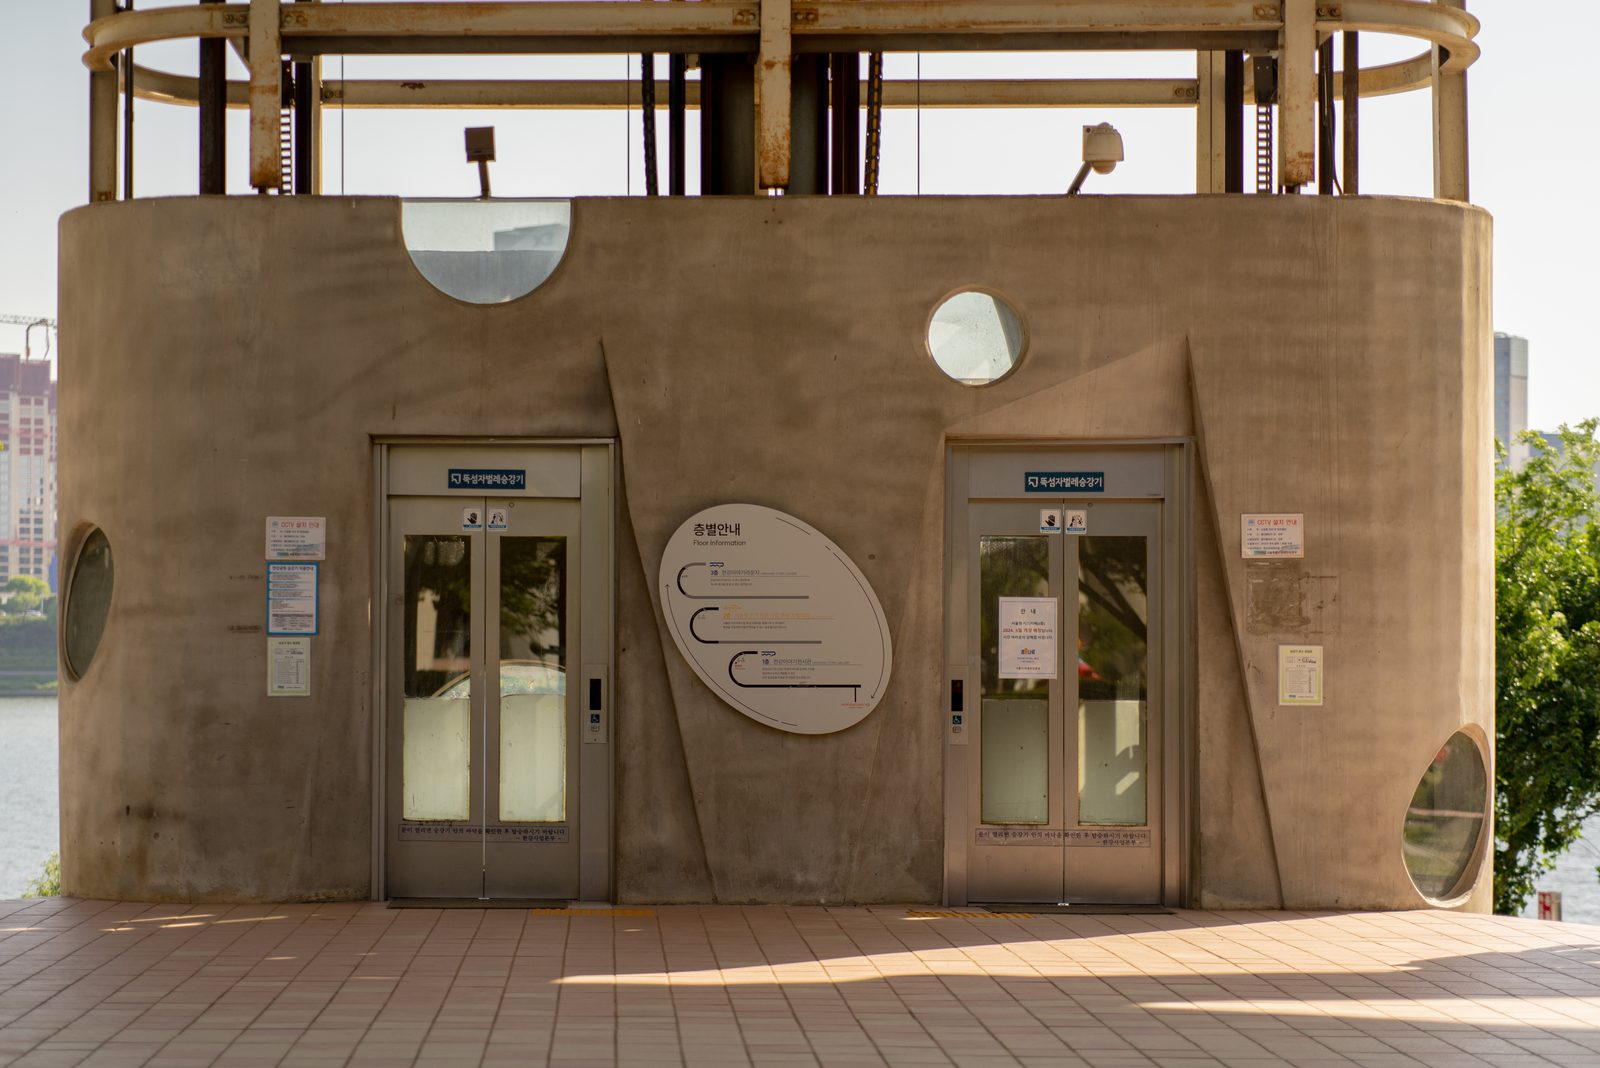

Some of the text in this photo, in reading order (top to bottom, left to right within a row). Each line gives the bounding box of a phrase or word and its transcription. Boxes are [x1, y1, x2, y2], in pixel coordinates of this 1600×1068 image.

[463, 473, 524, 485] 뚝섬자벌레승강기
[1040, 476, 1102, 488] 뚝섬자벌레승강기
[281, 521, 295, 529] CCTV
[1257, 519, 1272, 527] CCTV
[1286, 519, 1297, 527] 안내
[693, 523, 740, 537] 층별안내
